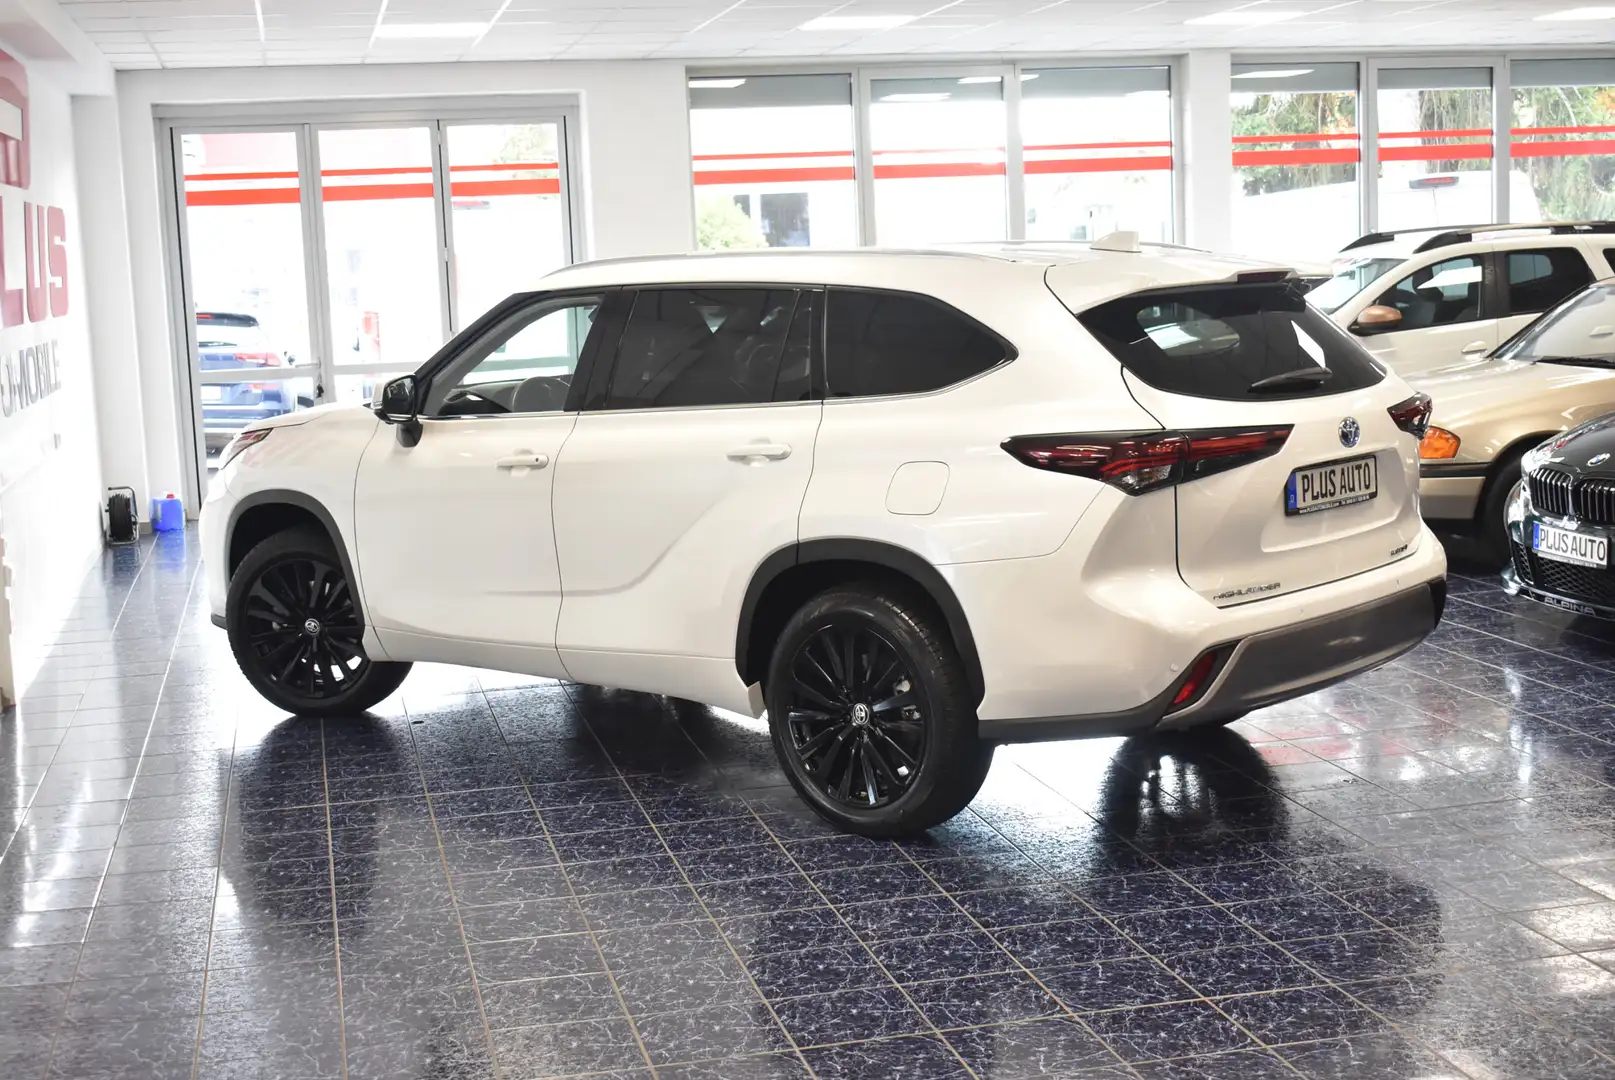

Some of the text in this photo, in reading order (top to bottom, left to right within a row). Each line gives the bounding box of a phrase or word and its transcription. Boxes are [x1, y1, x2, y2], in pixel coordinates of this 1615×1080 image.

[1301, 462, 1371, 502] PLUS AUTO
[1540, 528, 1569, 554] PLUS
[1570, 535, 1606, 561] AUTO
[1544, 596, 1596, 618] ALPINA
